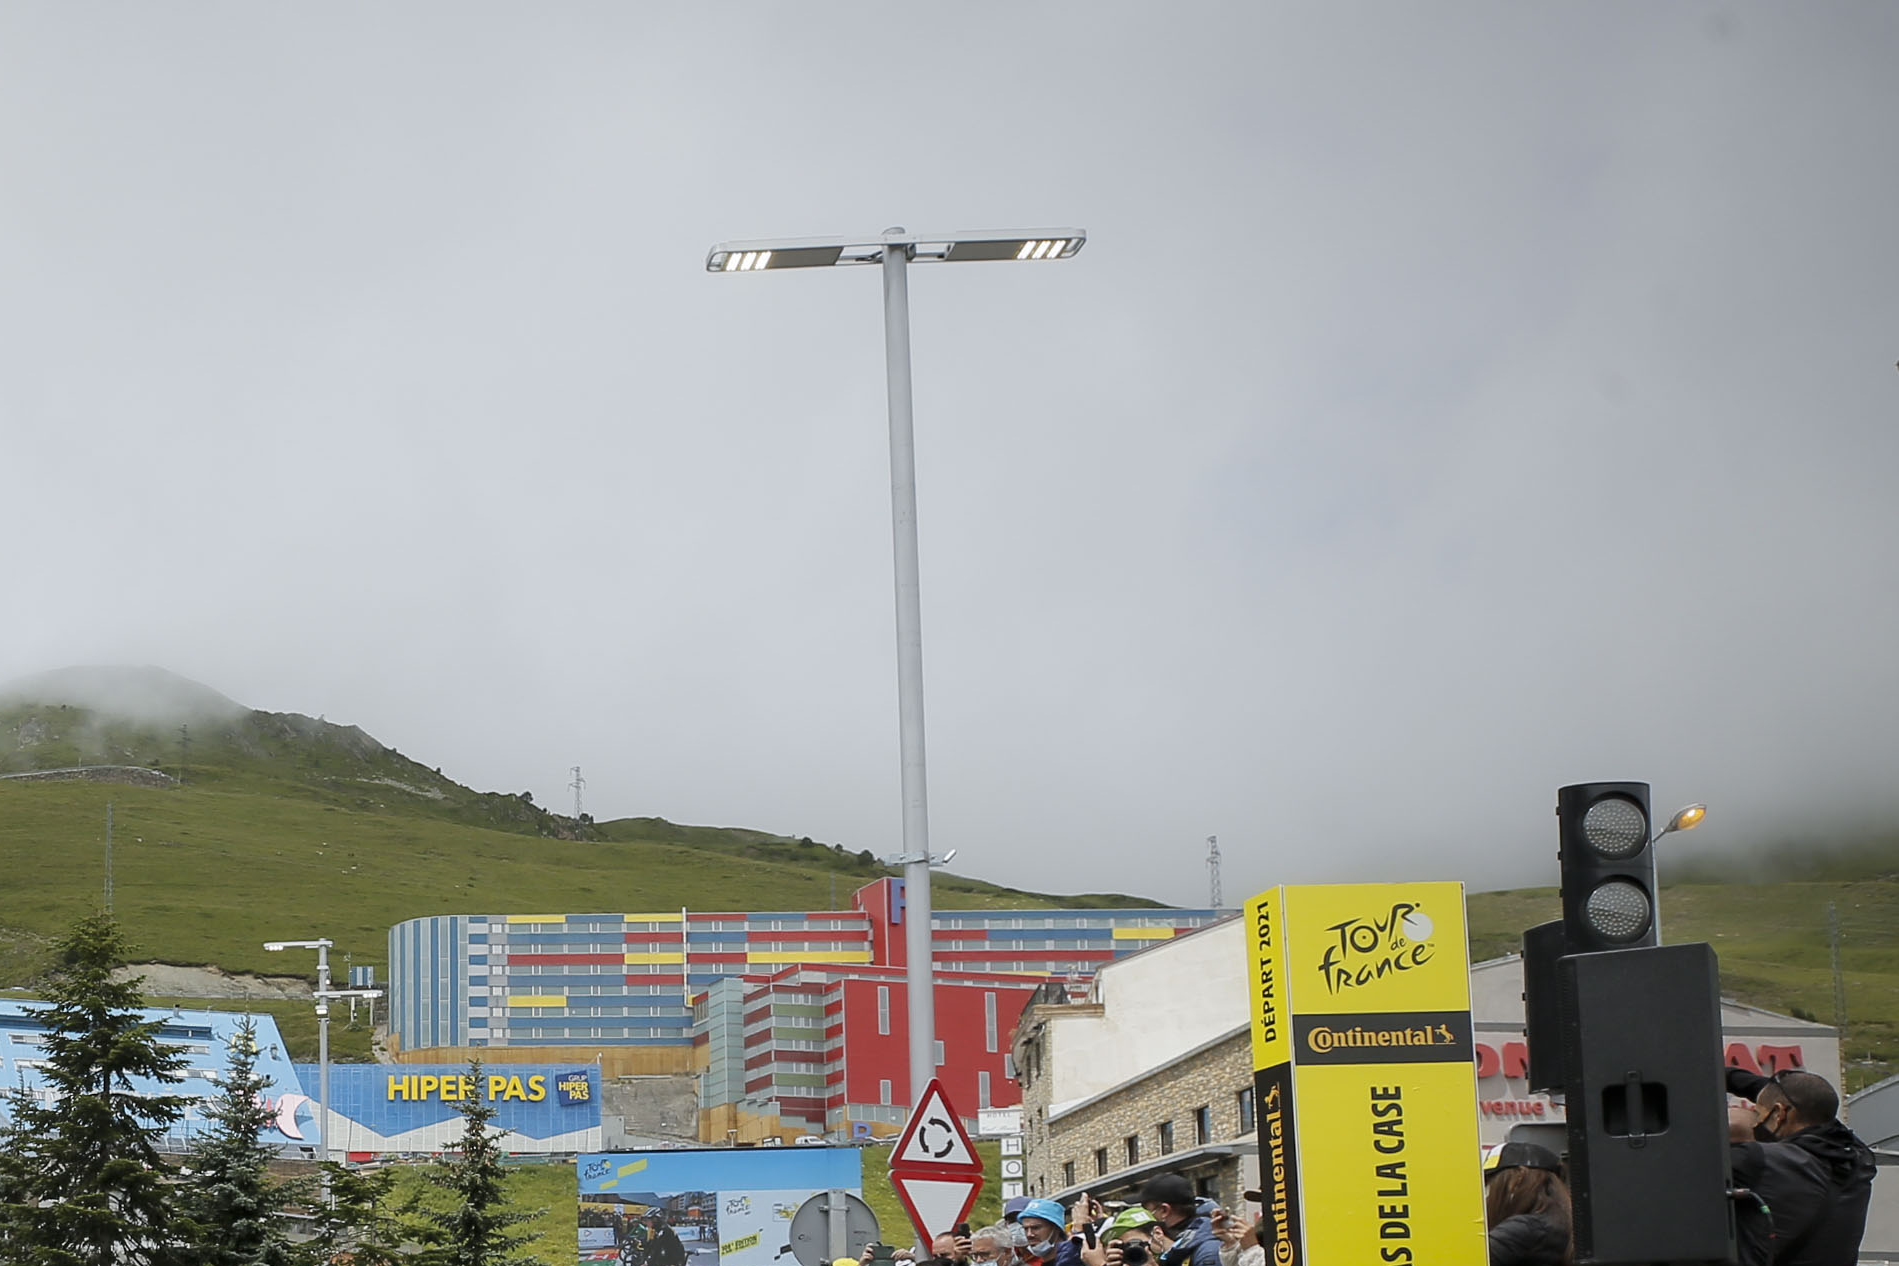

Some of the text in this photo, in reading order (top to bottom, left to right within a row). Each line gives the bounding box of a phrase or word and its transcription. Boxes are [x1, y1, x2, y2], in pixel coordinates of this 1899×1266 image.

[1324, 903, 1421, 957] TOUR
[1256, 901, 1277, 1044] DÉPART 2021
[1307, 1024, 1435, 1054] Continental
[488, 1075, 547, 1101] PAS
[558, 1082, 588, 1091] HIPER
[569, 1090, 590, 1100] PAS
[1370, 1085, 1406, 1155] CASE
[1375, 1160, 1408, 1198] LA
[1378, 1204, 1412, 1241] DE
